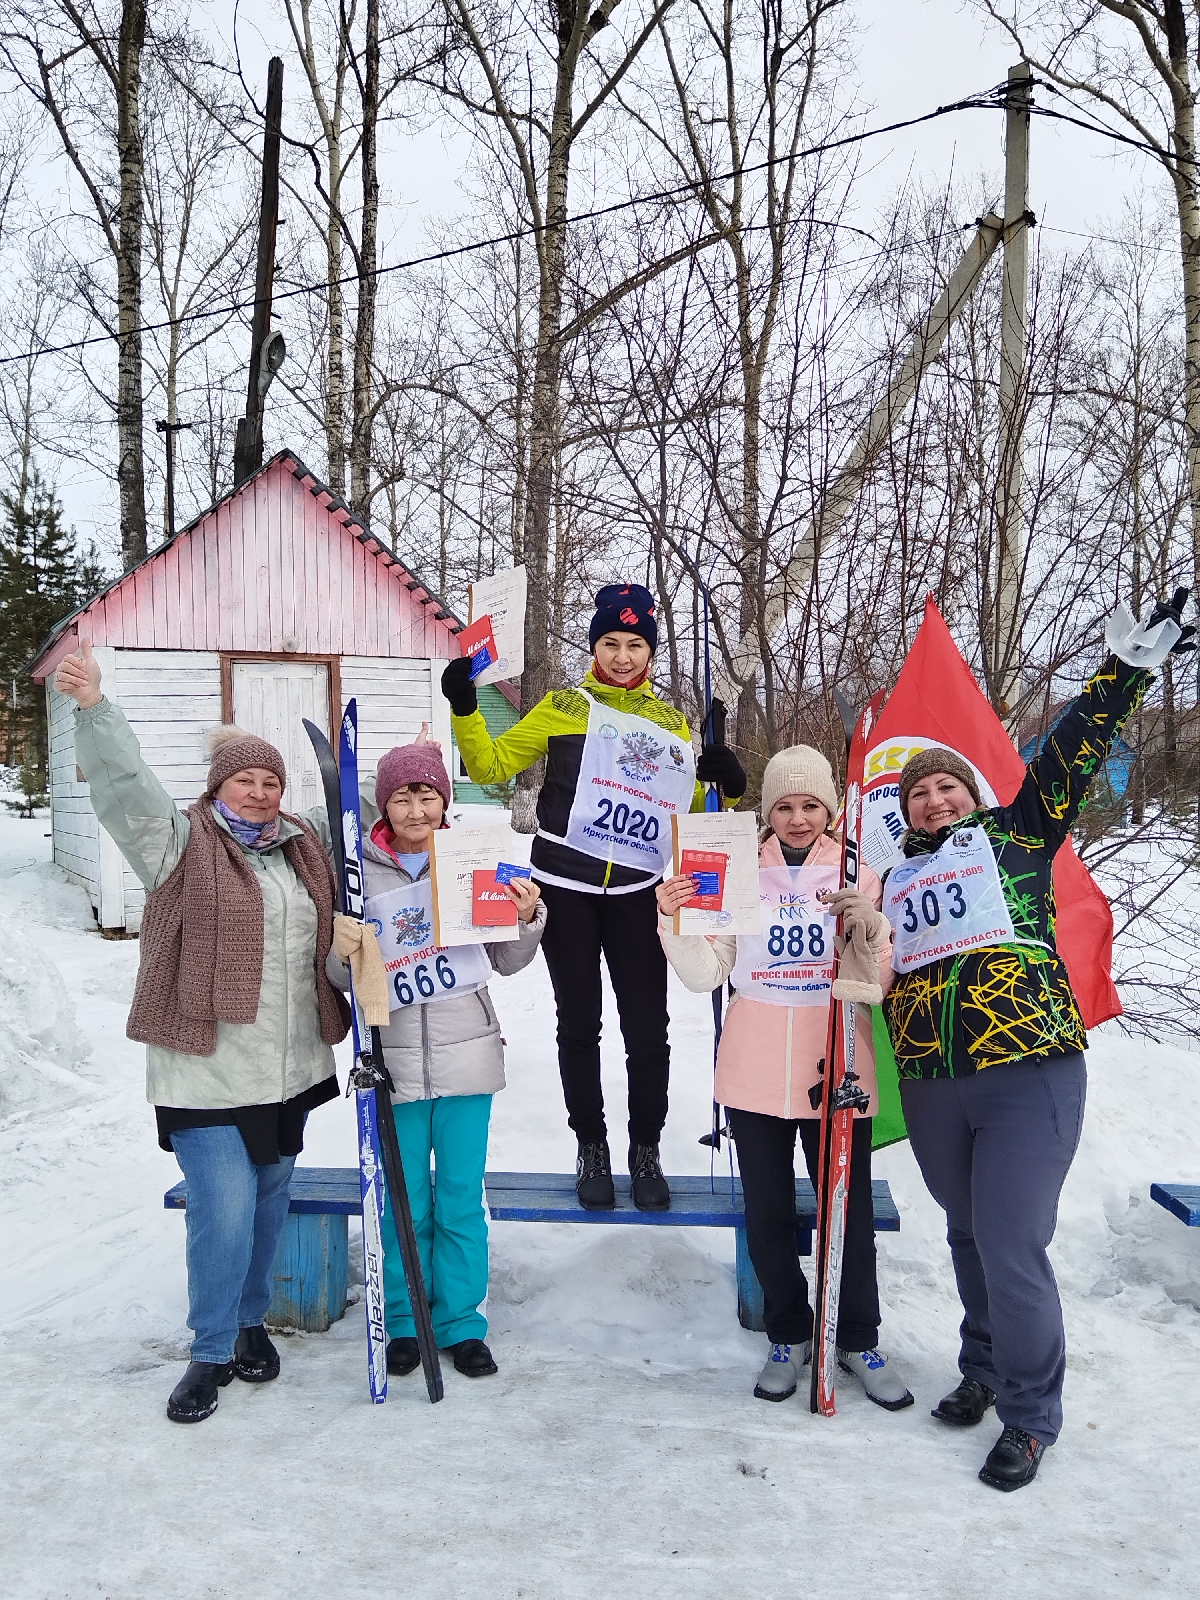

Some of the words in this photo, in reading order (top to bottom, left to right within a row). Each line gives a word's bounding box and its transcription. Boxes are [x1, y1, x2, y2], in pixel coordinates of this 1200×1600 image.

[620, 765, 653, 783] РОССИИ
[591, 777, 622, 793] ЛЫЖНЯ
[624, 786, 653, 803] РОССИИ
[869, 786, 900, 803] ПРОФ
[593, 798, 660, 842] 2020
[583, 825, 629, 846] Иркутская
[630, 840, 659, 855] область
[456, 872, 474, 881] ДИП
[891, 882, 917, 906] ЛЫЖНЯ
[918, 870, 957, 888] РОССИИ
[959, 865, 985, 879] 2009
[902, 882, 967, 933] 303
[767, 923, 825, 957] 888
[901, 943, 954, 965] ИРКУТСКАЯ
[955, 928, 1008, 949] ОБЛАСТЬ
[384, 955, 411, 972] ЖНЯ
[751, 970, 781, 981] КРОСС
[782, 969, 814, 980] НАЦИИ
[821, 969, 833, 979] 20
[393, 954, 456, 1005] 666
[801, 982, 831, 992] область
[366, 1242, 385, 1344] blazzer
